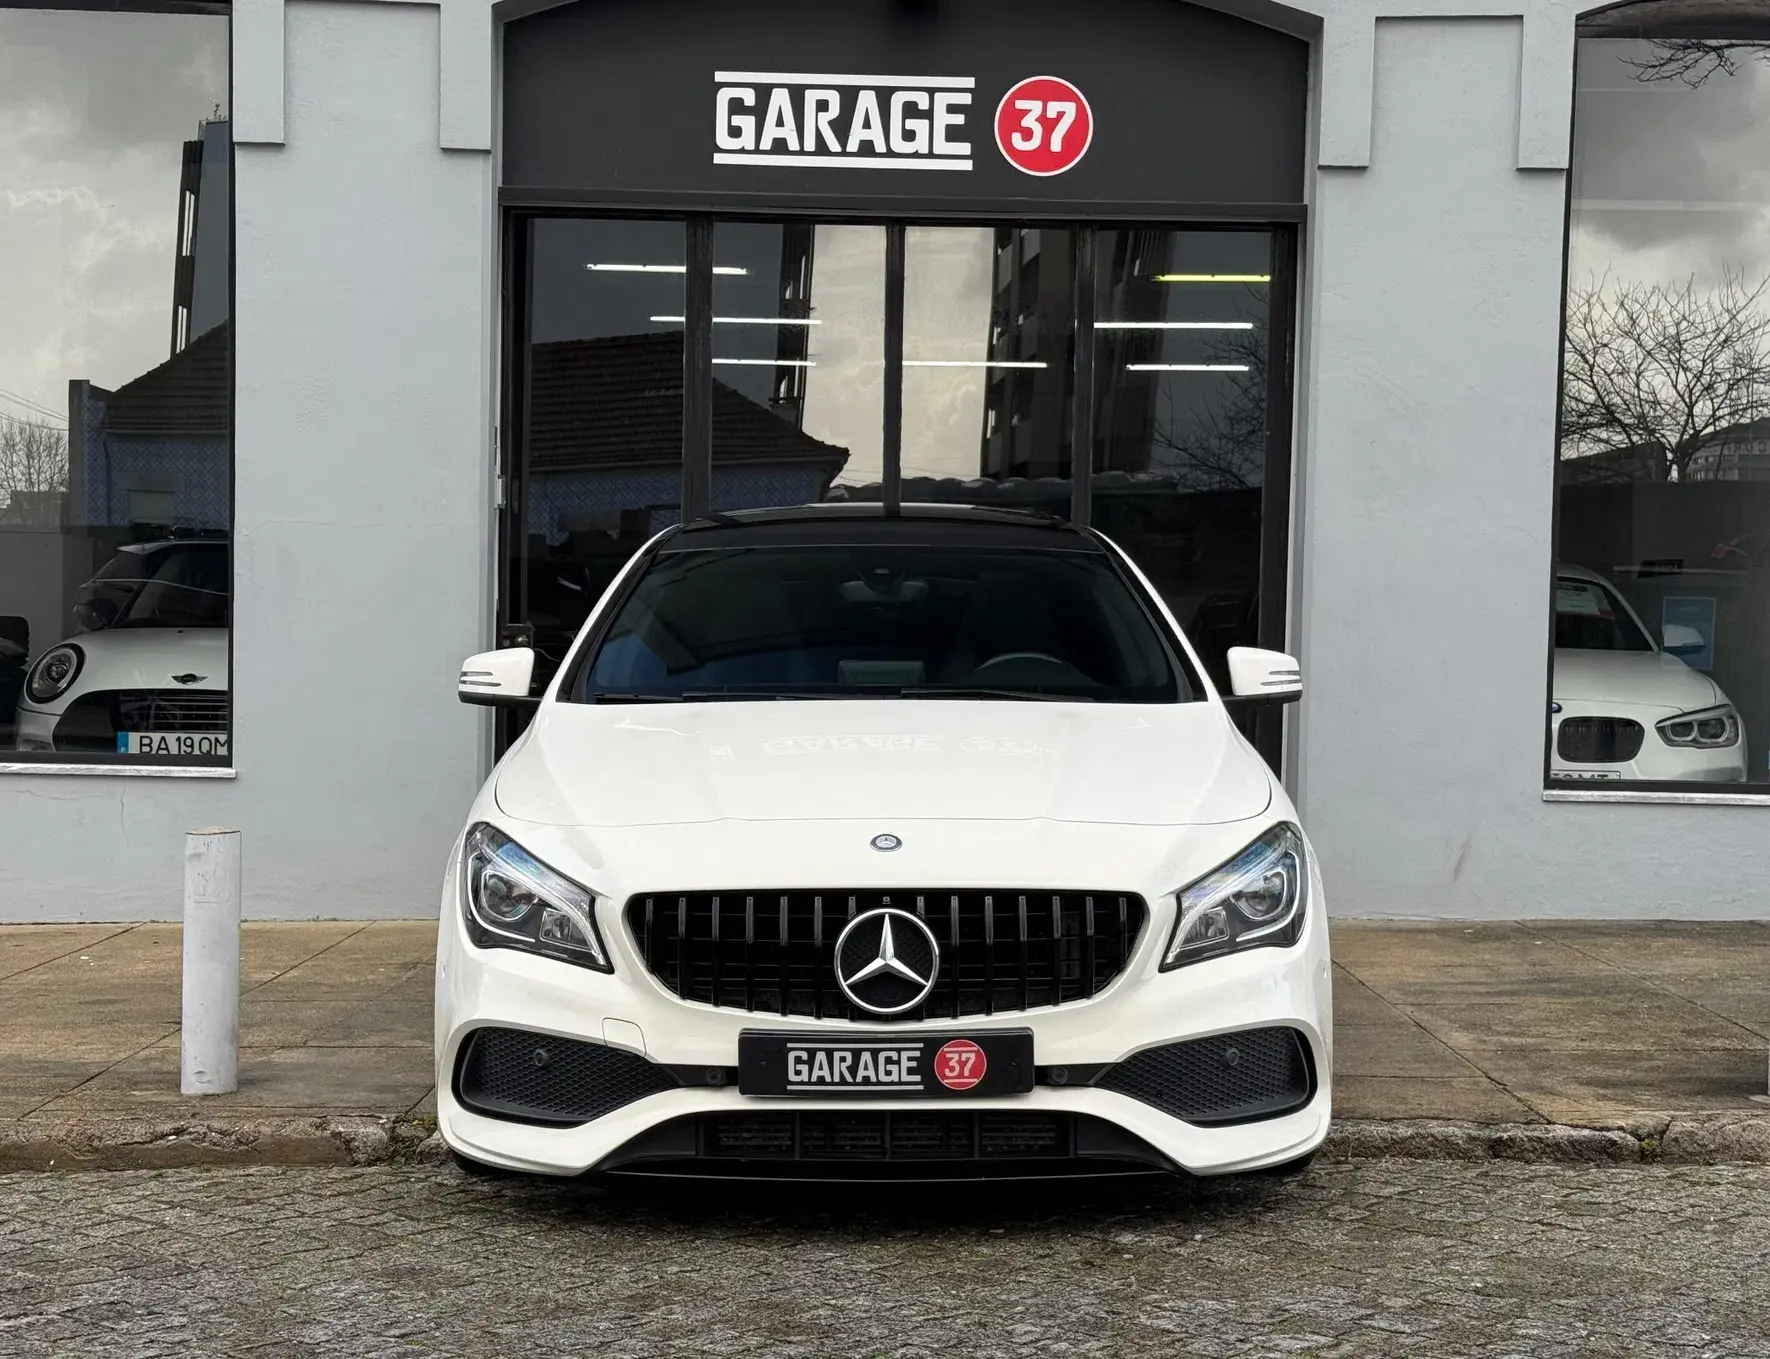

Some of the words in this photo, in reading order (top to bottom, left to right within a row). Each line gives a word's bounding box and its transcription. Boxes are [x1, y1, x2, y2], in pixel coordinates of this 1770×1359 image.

[715, 86, 972, 155] GARAGE
[1011, 99, 1077, 153] 37
[139, 735, 171, 755] BA
[175, 736, 195, 756] 19
[786, 1050, 922, 1083] GARAGE
[944, 1052, 976, 1077] 37
